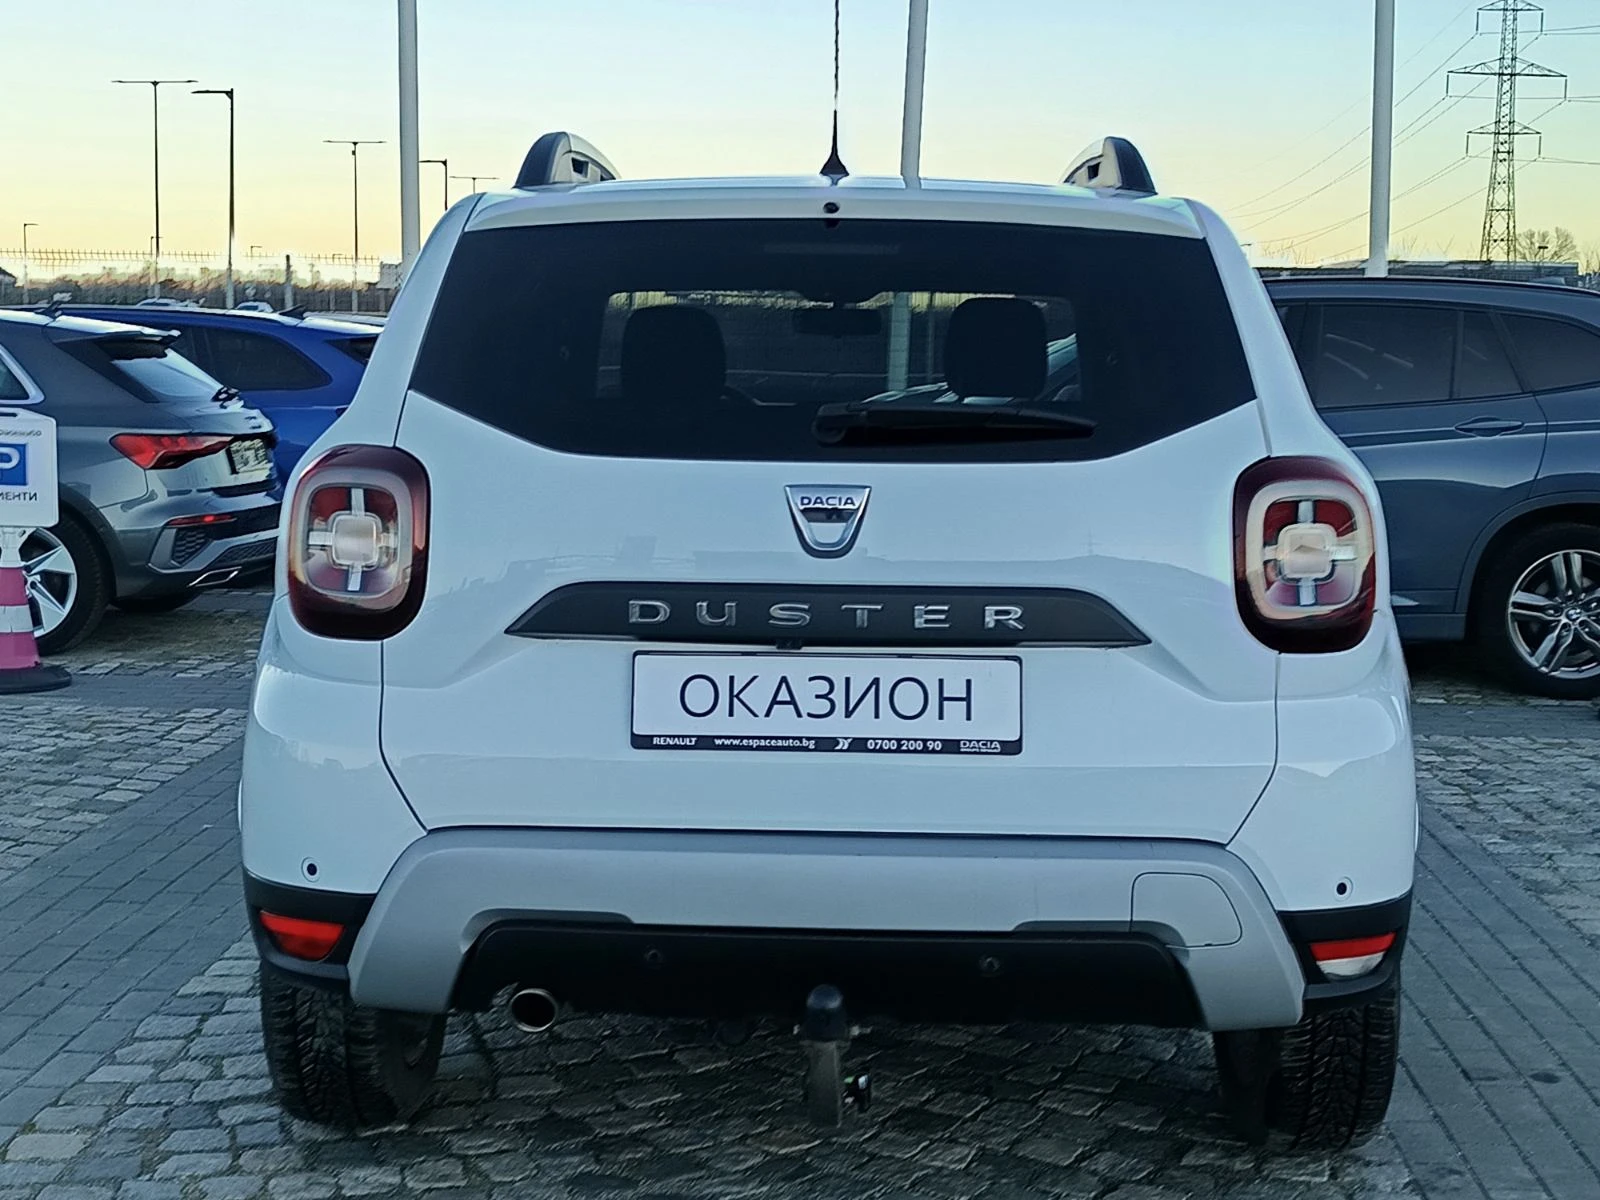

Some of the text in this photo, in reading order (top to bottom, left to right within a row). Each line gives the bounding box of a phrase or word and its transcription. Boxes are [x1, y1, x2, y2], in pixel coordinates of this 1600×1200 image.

[800, 496, 856, 506] DACIA
[628, 599, 1024, 630] DUSTER
[679, 673, 973, 722] ОКАЗИОН
[653, 736, 697, 746] RENAULT
[713, 737, 816, 750] www.espaceauto.bg
[866, 739, 943, 751] 0700 200 90
[959, 740, 1001, 749] DACIA
